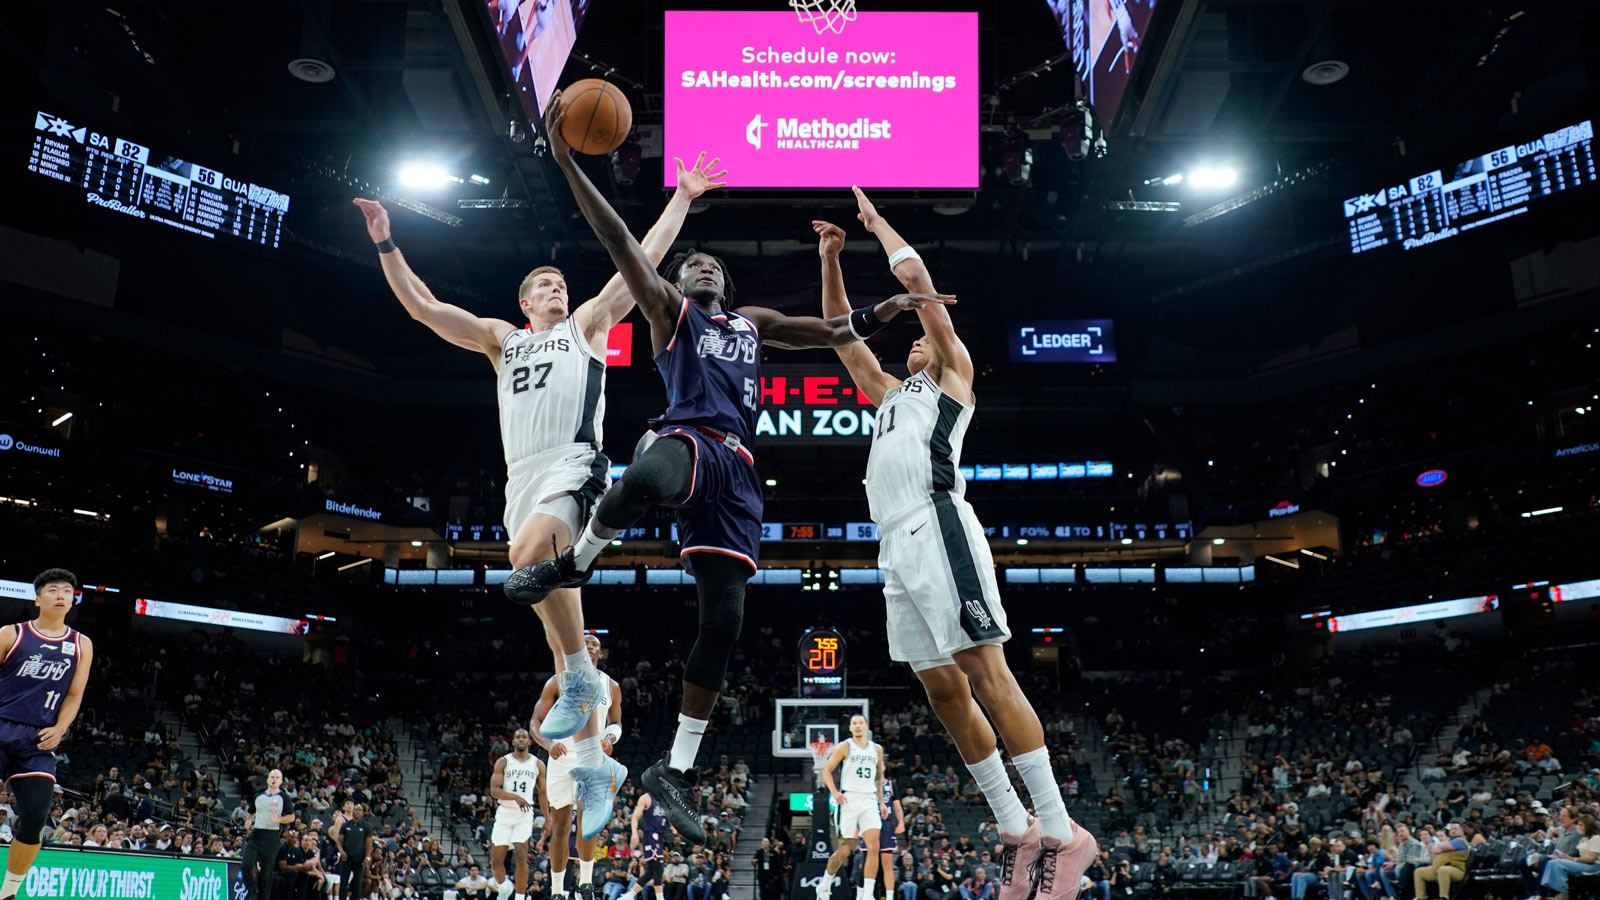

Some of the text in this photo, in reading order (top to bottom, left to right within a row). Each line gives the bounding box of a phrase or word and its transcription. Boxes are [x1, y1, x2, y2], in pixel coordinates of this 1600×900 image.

[742, 46, 896, 64] Schedule now:
[681, 70, 956, 92] SAHealth.com/screenings
[777, 118, 891, 138] Methodist
[45, 138, 69, 151] BRYANT
[90, 132, 109, 150] SA
[777, 140, 859, 149] HEALTHCARE
[1516, 139, 1545, 158] GUA
[121, 142, 140, 160] 82
[1491, 150, 1508, 166] 56
[40, 160, 58, 171] MINIX
[39, 168, 64, 181] WATERS
[198, 168, 215, 185] 56
[1418, 175, 1433, 191] 82
[201, 190, 222, 201] FRAZIER
[224, 178, 248, 196] GUA
[1388, 184, 1408, 200] SA
[87, 193, 146, 219] ProBaller
[196, 217, 220, 229] OLADIPO
[1403, 227, 1458, 250] ProBaller
[1033, 334, 1091, 348] LEDGER
[513, 362, 552, 394] 27
[760, 377, 873, 404] H-E-
[877, 405, 895, 439] 11
[16, 441, 60, 457] Ownwell
[172, 469, 200, 482] LONE
[206, 476, 232, 488] STAR
[326, 499, 382, 520] Bitdefender
[630, 528, 646, 537] PF
[760, 526, 771, 538] 2
[791, 526, 814, 538] 7:55
[858, 526, 872, 538] 56
[1020, 527, 1049, 537] FG%
[1074, 527, 1090, 536] TO
[814, 638, 838, 650] 7:55
[809, 650, 835, 669] 20
[44, 690, 60, 710] 11
[507, 769, 535, 779] SPURS
[856, 767, 871, 778] 43
[512, 781, 526, 792] 14
[26, 866, 69, 897] OBEY
[70, 868, 109, 898] YOUR
[180, 867, 221, 900] Sprite
